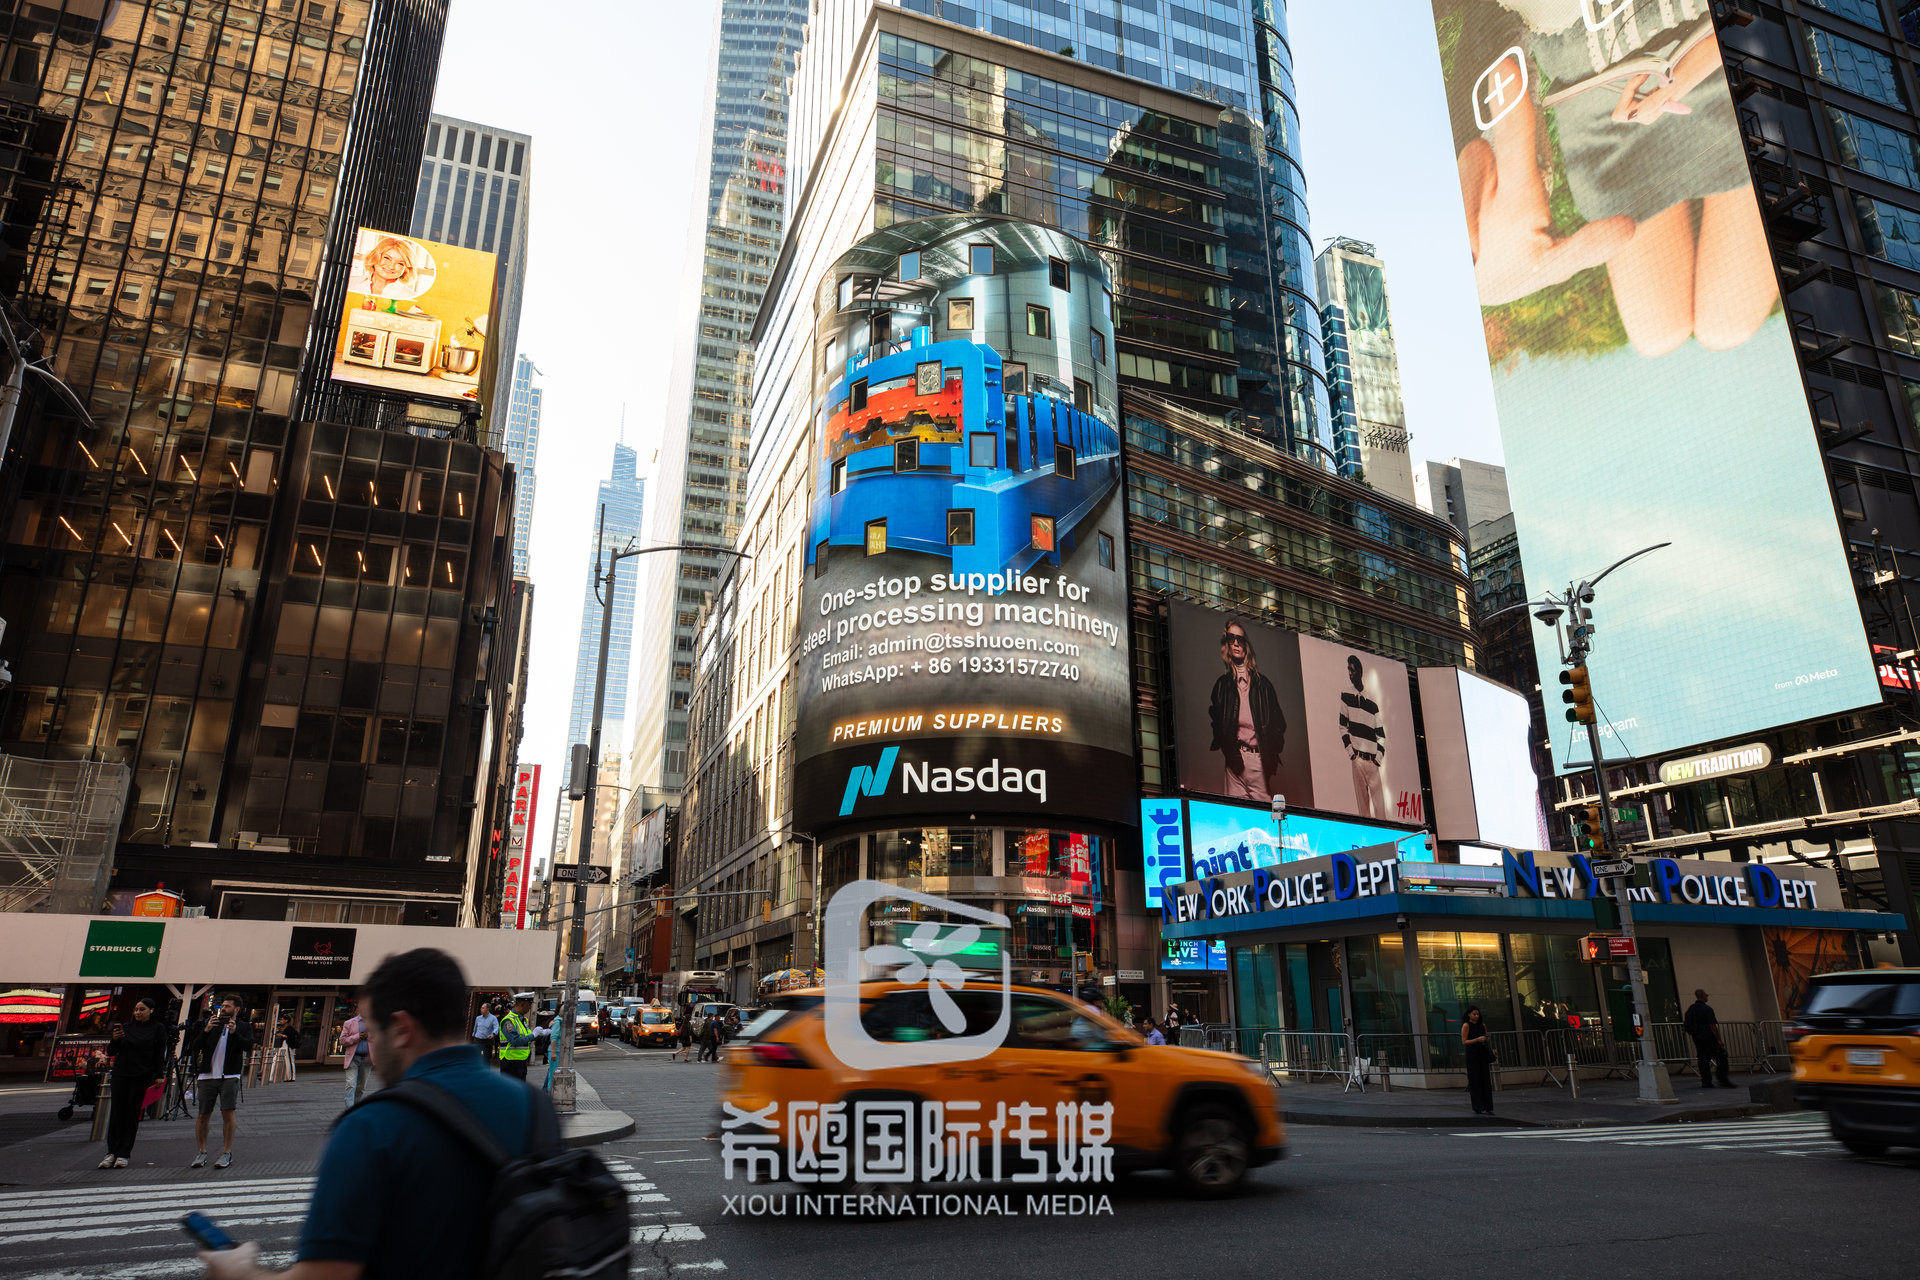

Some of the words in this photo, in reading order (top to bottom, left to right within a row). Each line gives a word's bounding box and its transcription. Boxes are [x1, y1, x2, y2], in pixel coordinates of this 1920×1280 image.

[820, 572, 921, 616] One-stop
[930, 569, 1049, 595] supplier
[1057, 575, 1090, 603] for
[802, 632, 831, 657] steel
[837, 598, 983, 643] processing
[994, 599, 1118, 647] machinery
[822, 643, 863, 670] Email:
[868, 632, 1080, 657] admin@tsshuoen.com
[821, 662, 904, 693] WhatsApp:
[928, 657, 951, 674] 86
[958, 656, 1080, 681] 19331572740
[1774, 681, 1792, 690] from
[1809, 668, 1838, 682] Meta
[833, 715, 922, 742] PREMIUM
[933, 713, 1063, 734] SUPPLIERS
[1572, 717, 1638, 743] Insagram
[513, 772, 531, 825] PARK
[902, 758, 1047, 803] Nasdaq
[1397, 790, 1422, 822] H&M
[504, 858, 521, 912] PARK
[1502, 848, 1576, 899] NEW
[1654, 858, 1750, 907] POLICE
[1752, 863, 1818, 909] DEPT
[1595, 865, 1608, 874] ONE
[1614, 863, 1628, 872] WAY
[1160, 885, 1199, 924] NEW
[1199, 878, 1250, 919] YORK
[1253, 868, 1326, 912] POLICE
[1331, 853, 1398, 900] DEPT
[1026, 906, 1047, 914] Nasdaq
[89, 945, 142, 953] STARBUCKS
